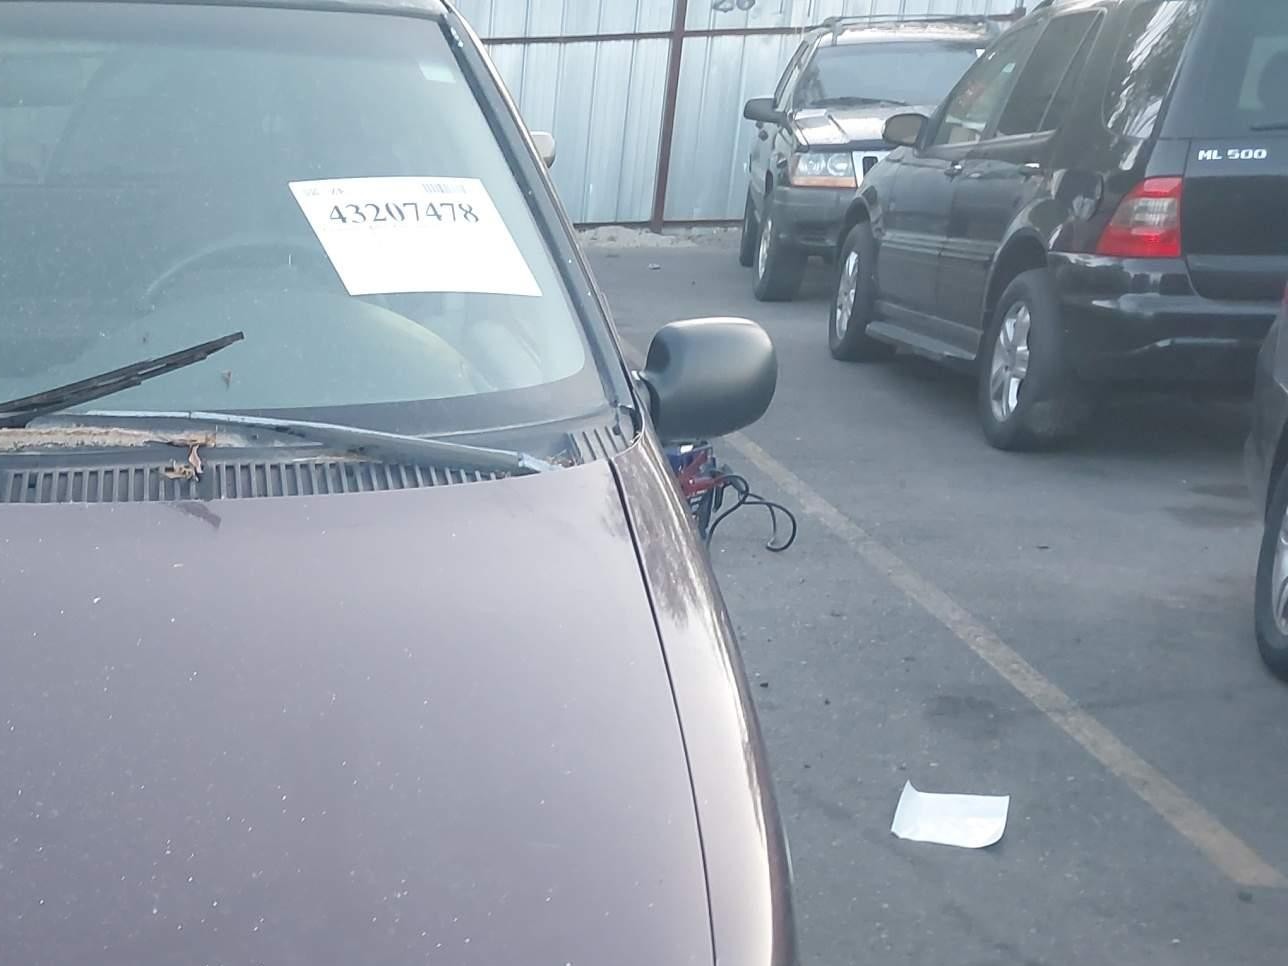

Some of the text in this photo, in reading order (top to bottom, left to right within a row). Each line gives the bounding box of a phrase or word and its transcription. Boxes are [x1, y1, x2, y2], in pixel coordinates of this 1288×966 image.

[1198, 148, 1268, 160] ML 500
[328, 201, 480, 225] 43207478
